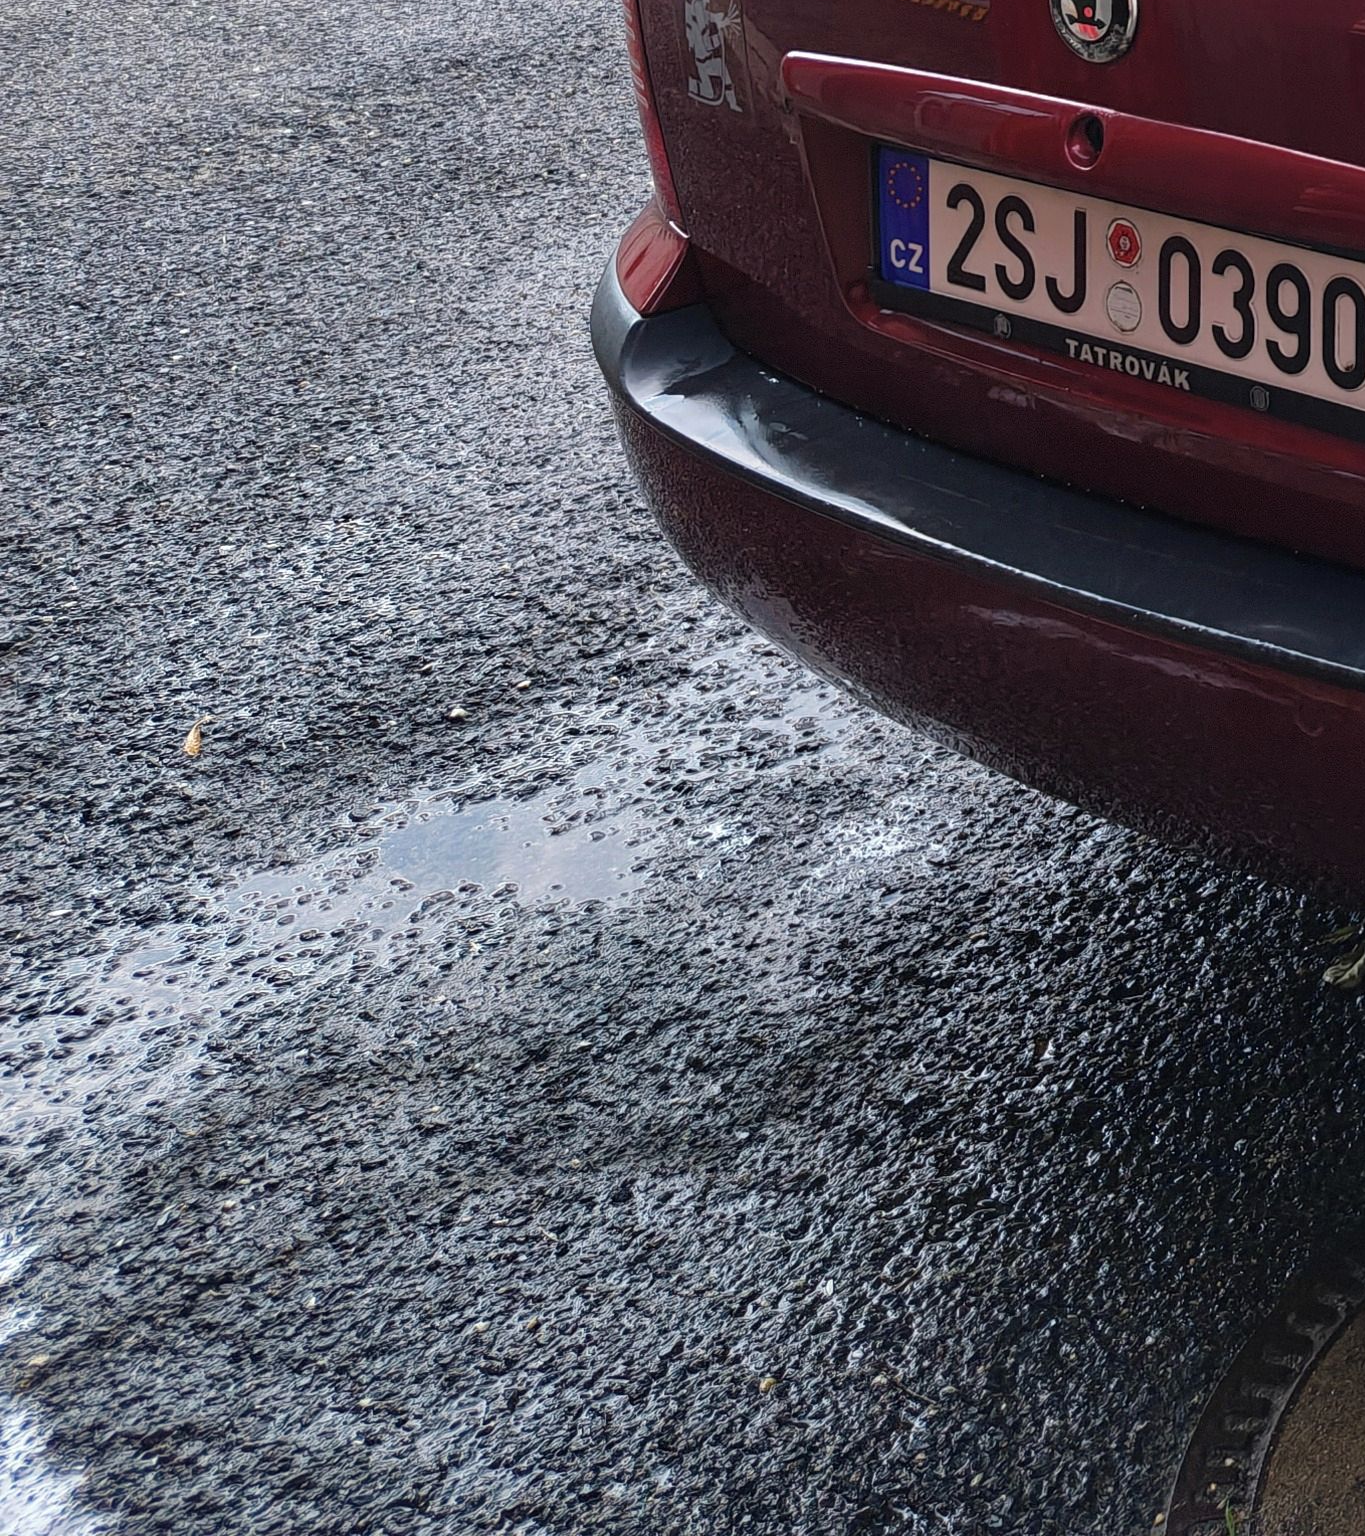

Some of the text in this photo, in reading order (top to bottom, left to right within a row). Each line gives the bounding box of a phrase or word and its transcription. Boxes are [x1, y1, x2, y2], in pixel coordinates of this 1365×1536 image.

[889, 237, 924, 274] CZ
[945, 183, 1088, 314] 2SJ
[1065, 337, 1192, 391] TATROVÁK
